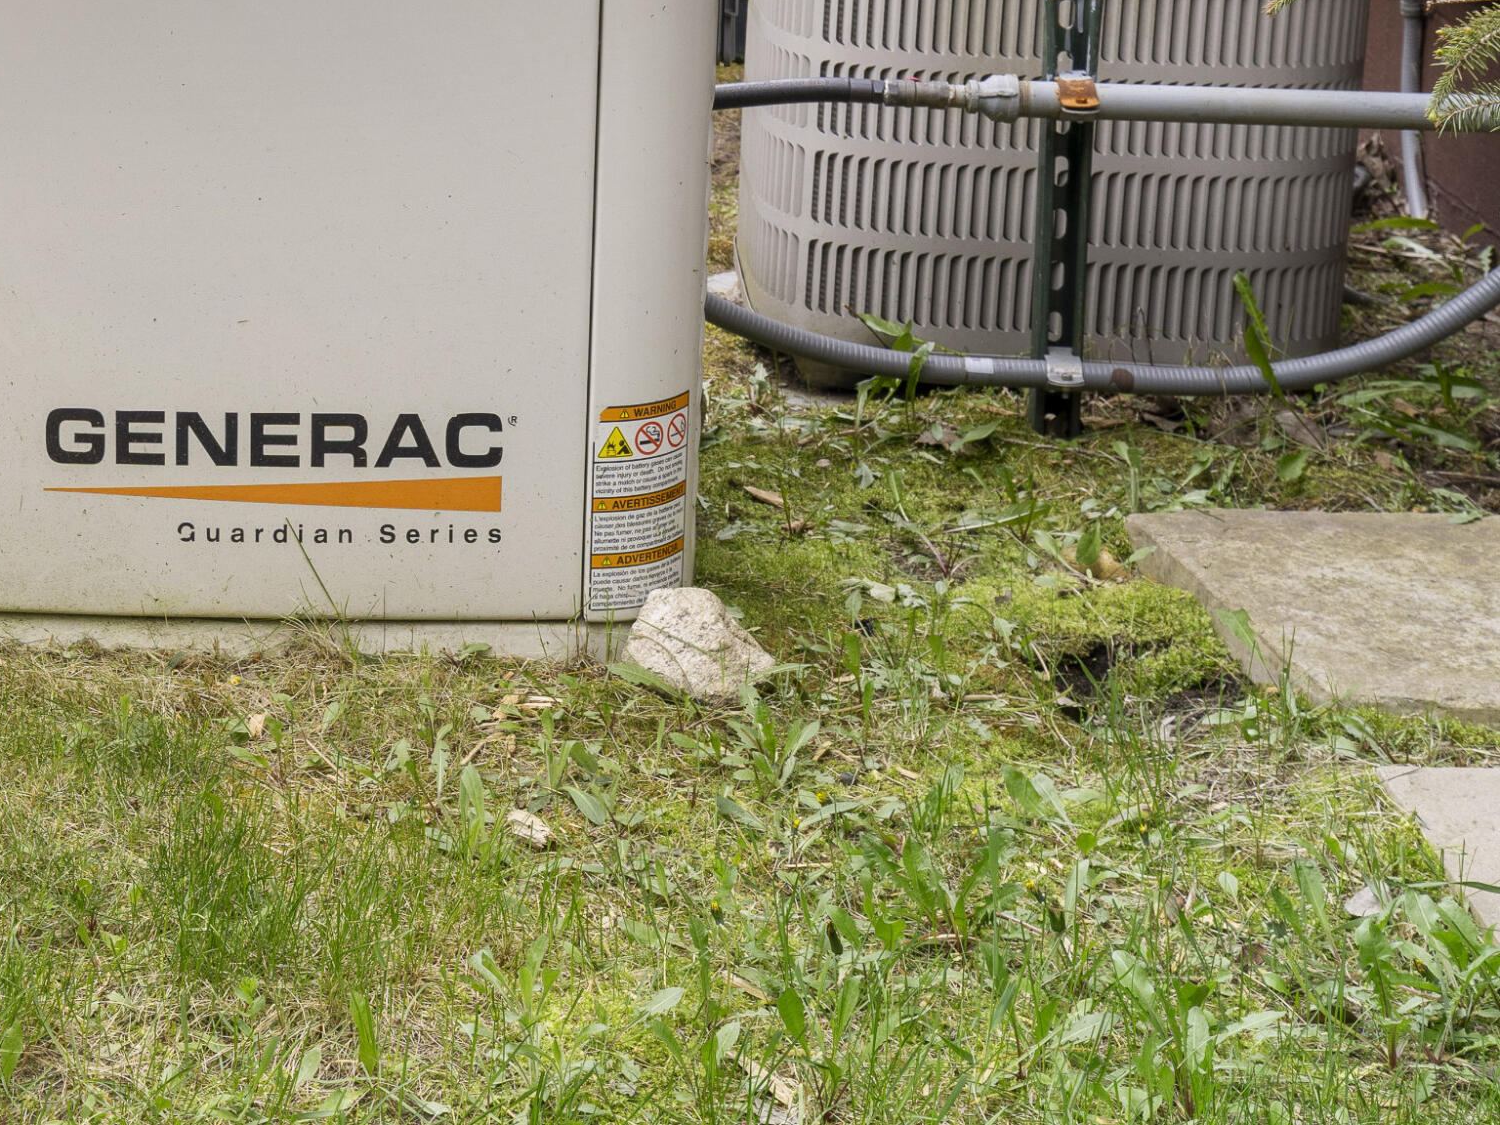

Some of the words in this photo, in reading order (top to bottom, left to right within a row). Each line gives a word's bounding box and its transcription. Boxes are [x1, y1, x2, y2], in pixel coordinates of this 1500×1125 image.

[633, 400, 677, 417] WARNING
[45, 408, 503, 468] GENERAC
[612, 484, 684, 510] AVERTISSEMENT
[177, 522, 353, 544] Guardian
[379, 524, 501, 544] Series
[616, 543, 678, 565] ADVERTENCIA
